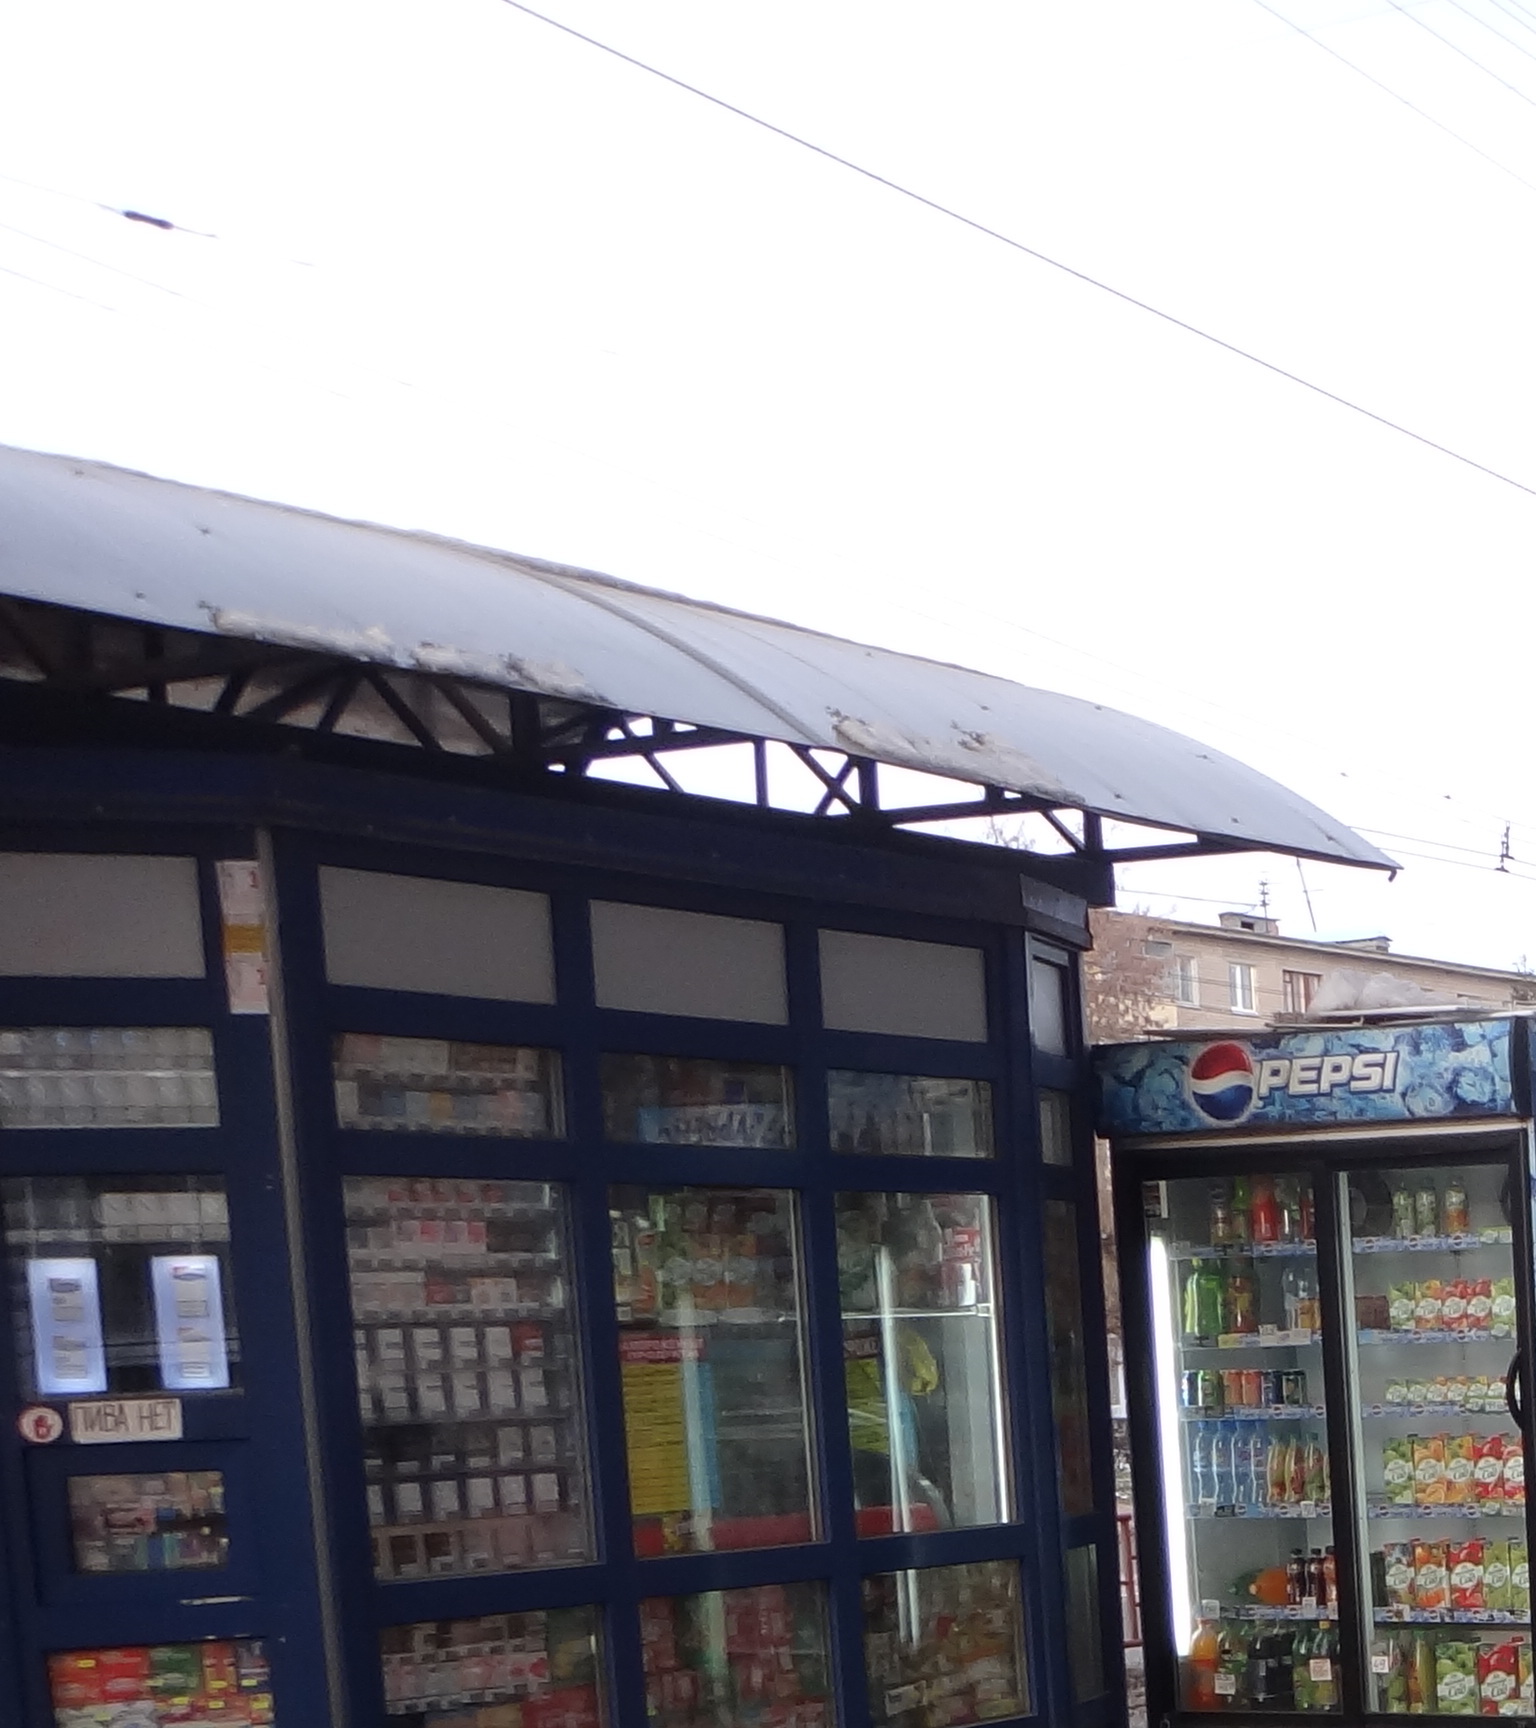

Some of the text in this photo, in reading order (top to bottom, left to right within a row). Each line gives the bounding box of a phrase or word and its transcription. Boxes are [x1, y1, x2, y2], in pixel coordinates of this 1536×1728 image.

[1258, 1051, 1399, 1098] PEPSI
[74, 1400, 175, 1432] ПИВА НЕТ
